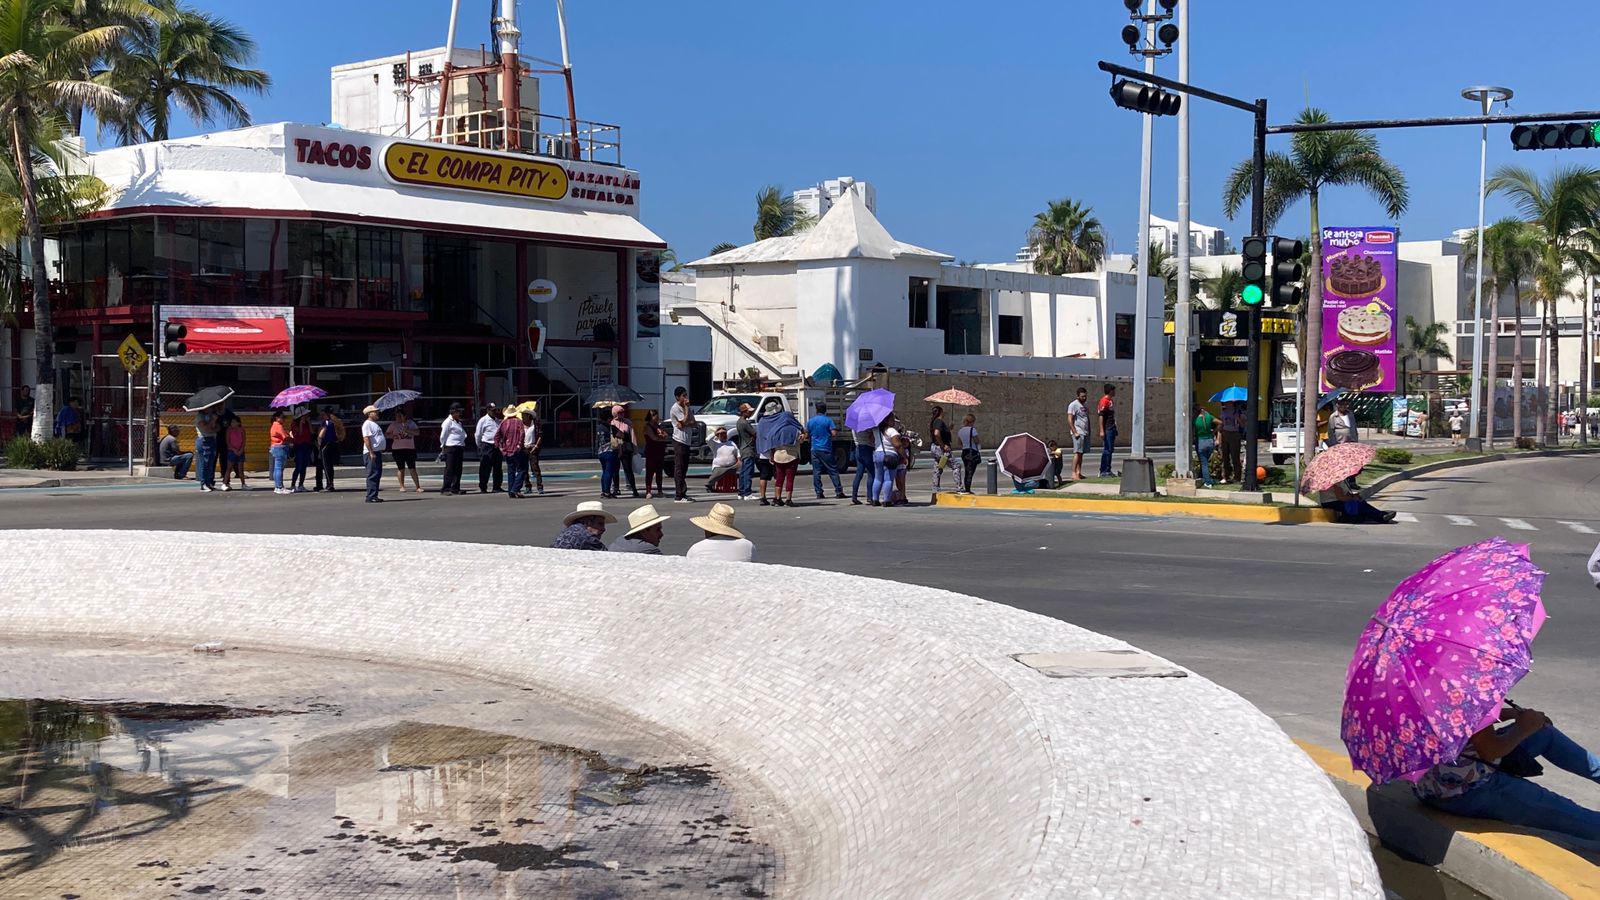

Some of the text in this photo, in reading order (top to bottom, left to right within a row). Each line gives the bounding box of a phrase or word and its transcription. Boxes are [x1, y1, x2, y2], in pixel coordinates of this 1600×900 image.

[295, 139, 372, 169] TACOS
[406, 152, 550, 190] EL COMPA PITY
[571, 187, 634, 205] SINALOA
[1329, 239, 1360, 247] mucho
[1333, 230, 1364, 240] antoja
